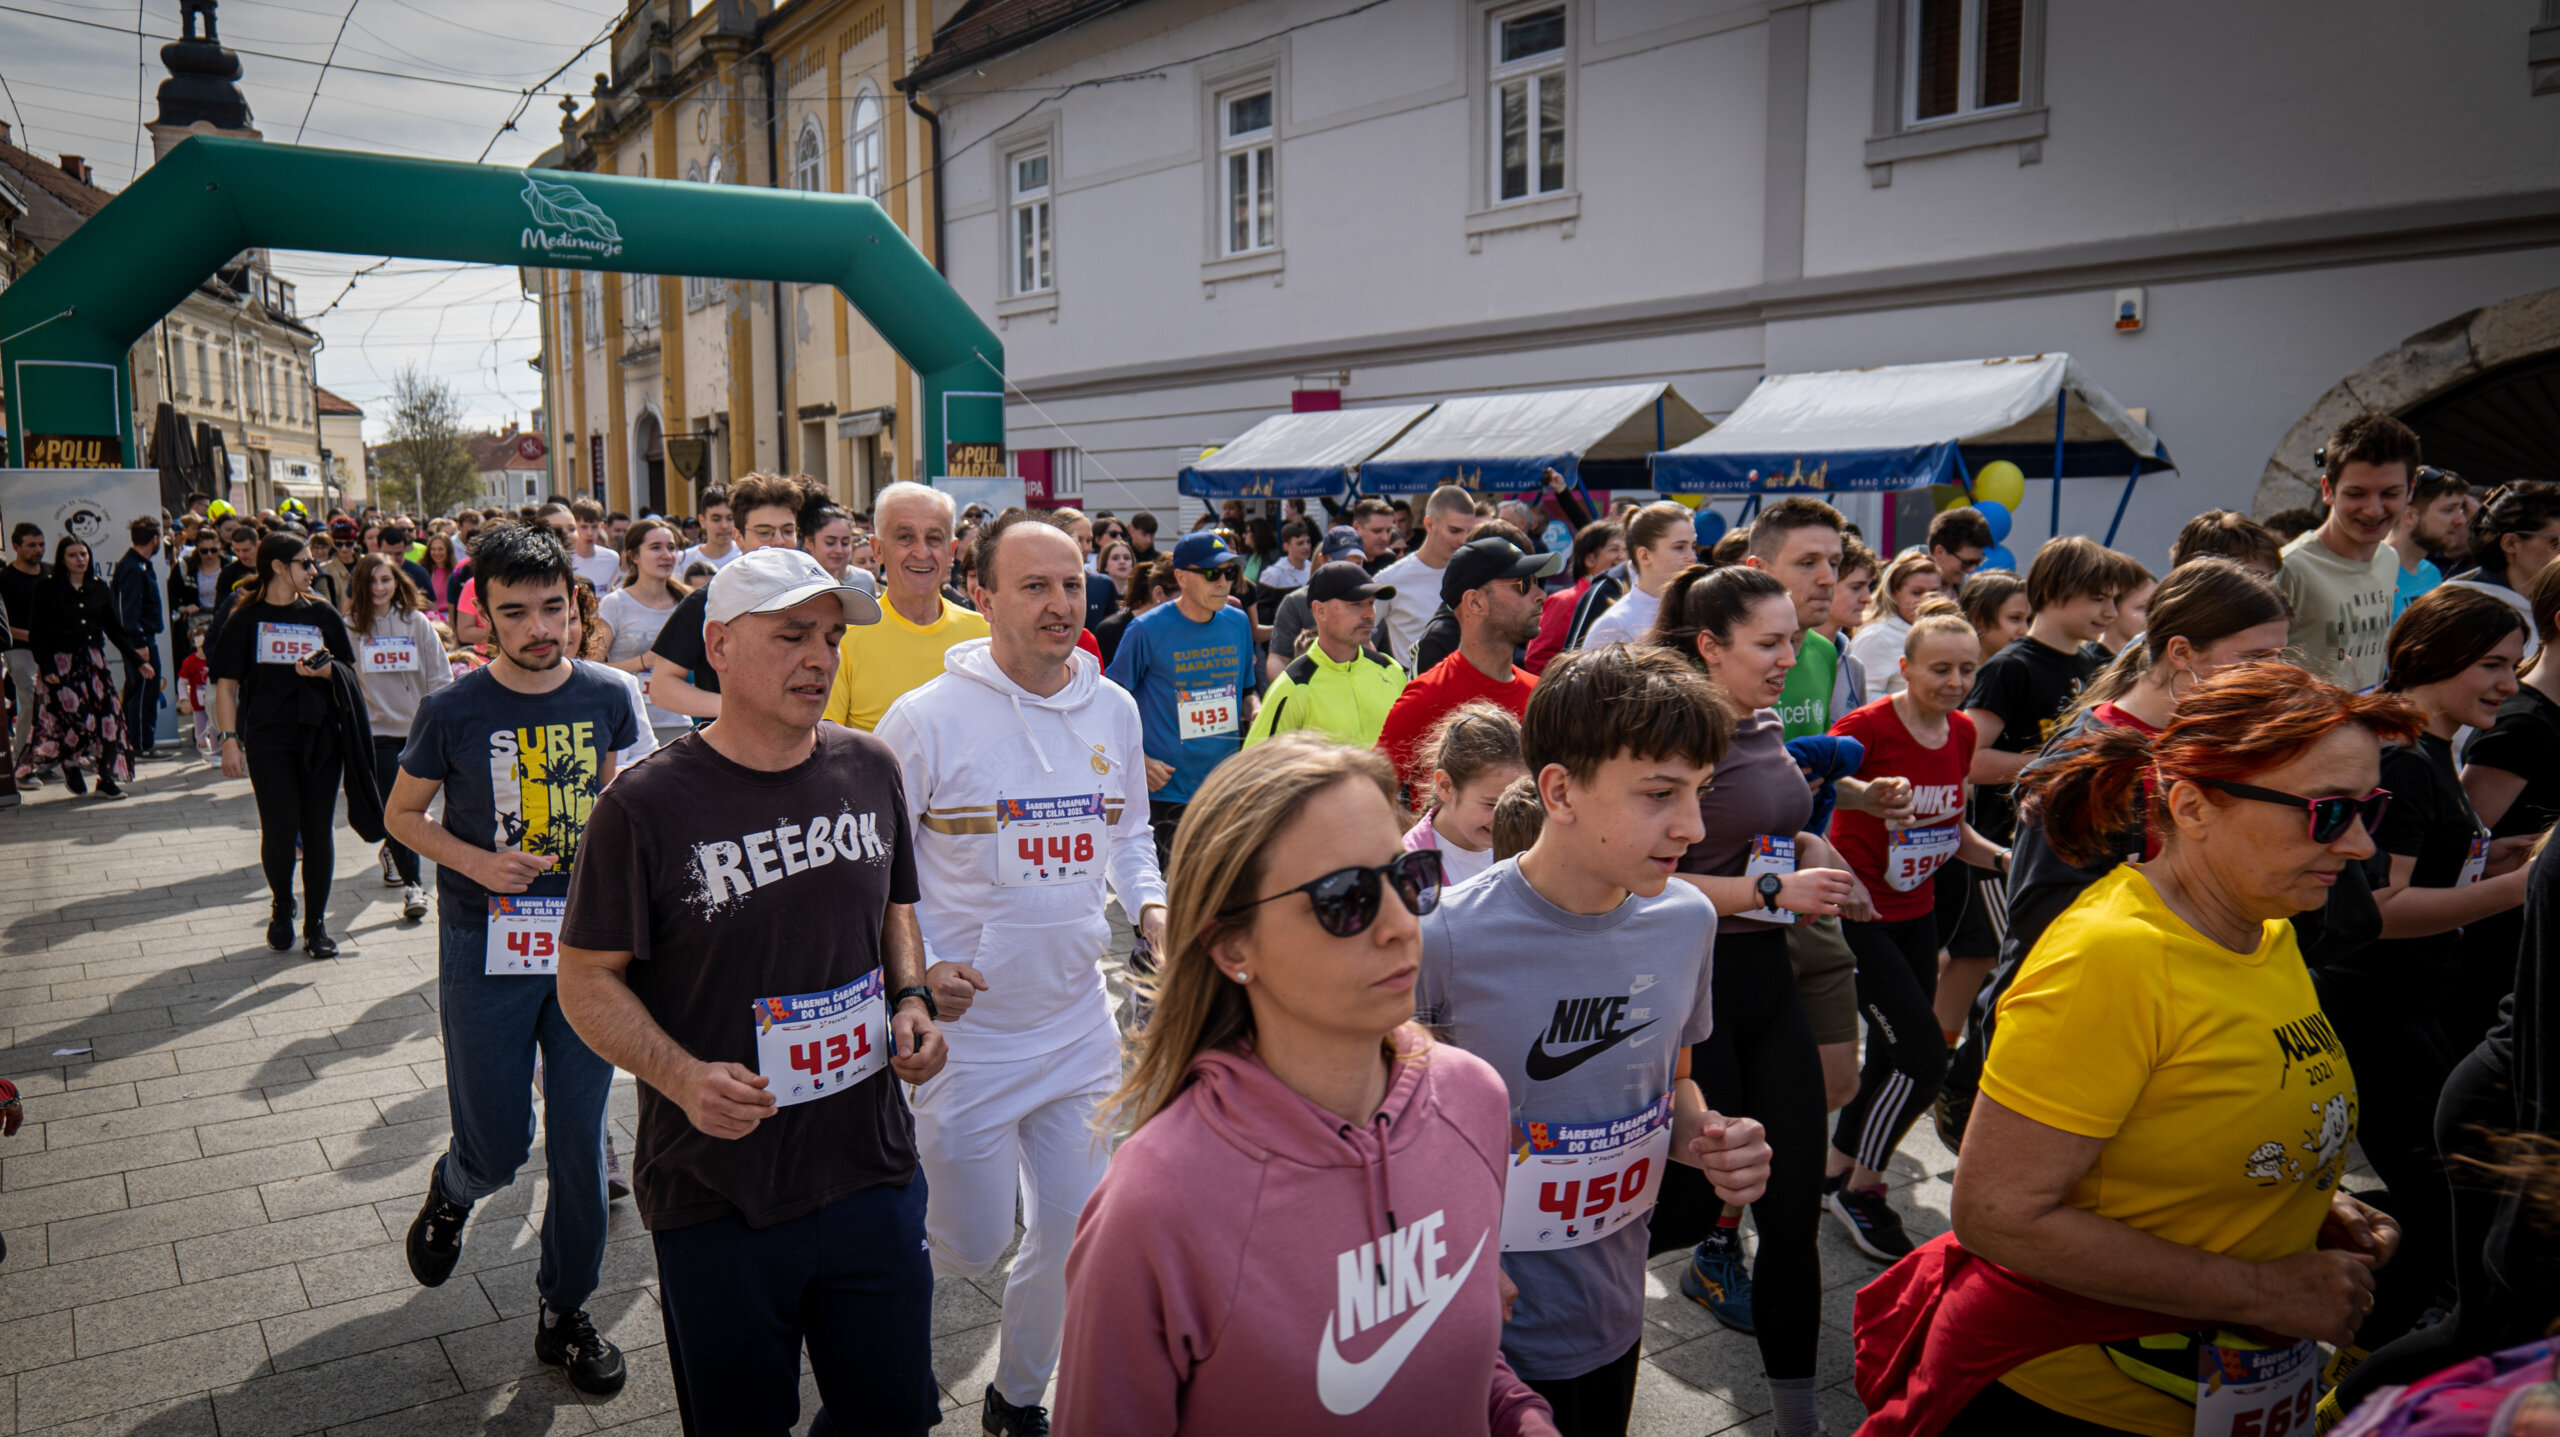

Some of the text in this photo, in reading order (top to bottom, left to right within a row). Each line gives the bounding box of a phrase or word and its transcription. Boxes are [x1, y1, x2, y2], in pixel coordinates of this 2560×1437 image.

[46, 439, 101, 462] POLU
[964, 446, 998, 463] POLU
[1024, 480, 1044, 497] IPA
[2353, 590, 2385, 608] NIKE
[272, 641, 313, 654] 055
[374, 652, 410, 664] 054
[1173, 645, 1237, 661] EUROPSKI
[1175, 657, 1239, 673] MARATON
[1191, 707, 1229, 725] 433
[1775, 698, 1811, 724] icef
[1912, 785, 1959, 815] NIKE
[1032, 810, 1043, 819] DO
[698, 811, 886, 905] REEBOK
[1018, 833, 1094, 866] 448
[507, 931, 560, 956] 43
[801, 1009, 816, 1020] DO
[818, 1004, 843, 1017] CILJA
[1546, 995, 1630, 1044] NIKE
[1870, 1004, 1897, 1044] adidas
[789, 1022, 871, 1076] 431
[2305, 1060, 2335, 1087] 2021
[1558, 1106, 1658, 1140] ŠARENIM ČARAPAMA
[1568, 1140, 1586, 1153] DO
[1590, 1136, 1620, 1152] CILJA
[1539, 1157, 1650, 1221] 450
[1338, 1209, 1449, 1342] NIKE
[2230, 1377, 2315, 1437] 569
